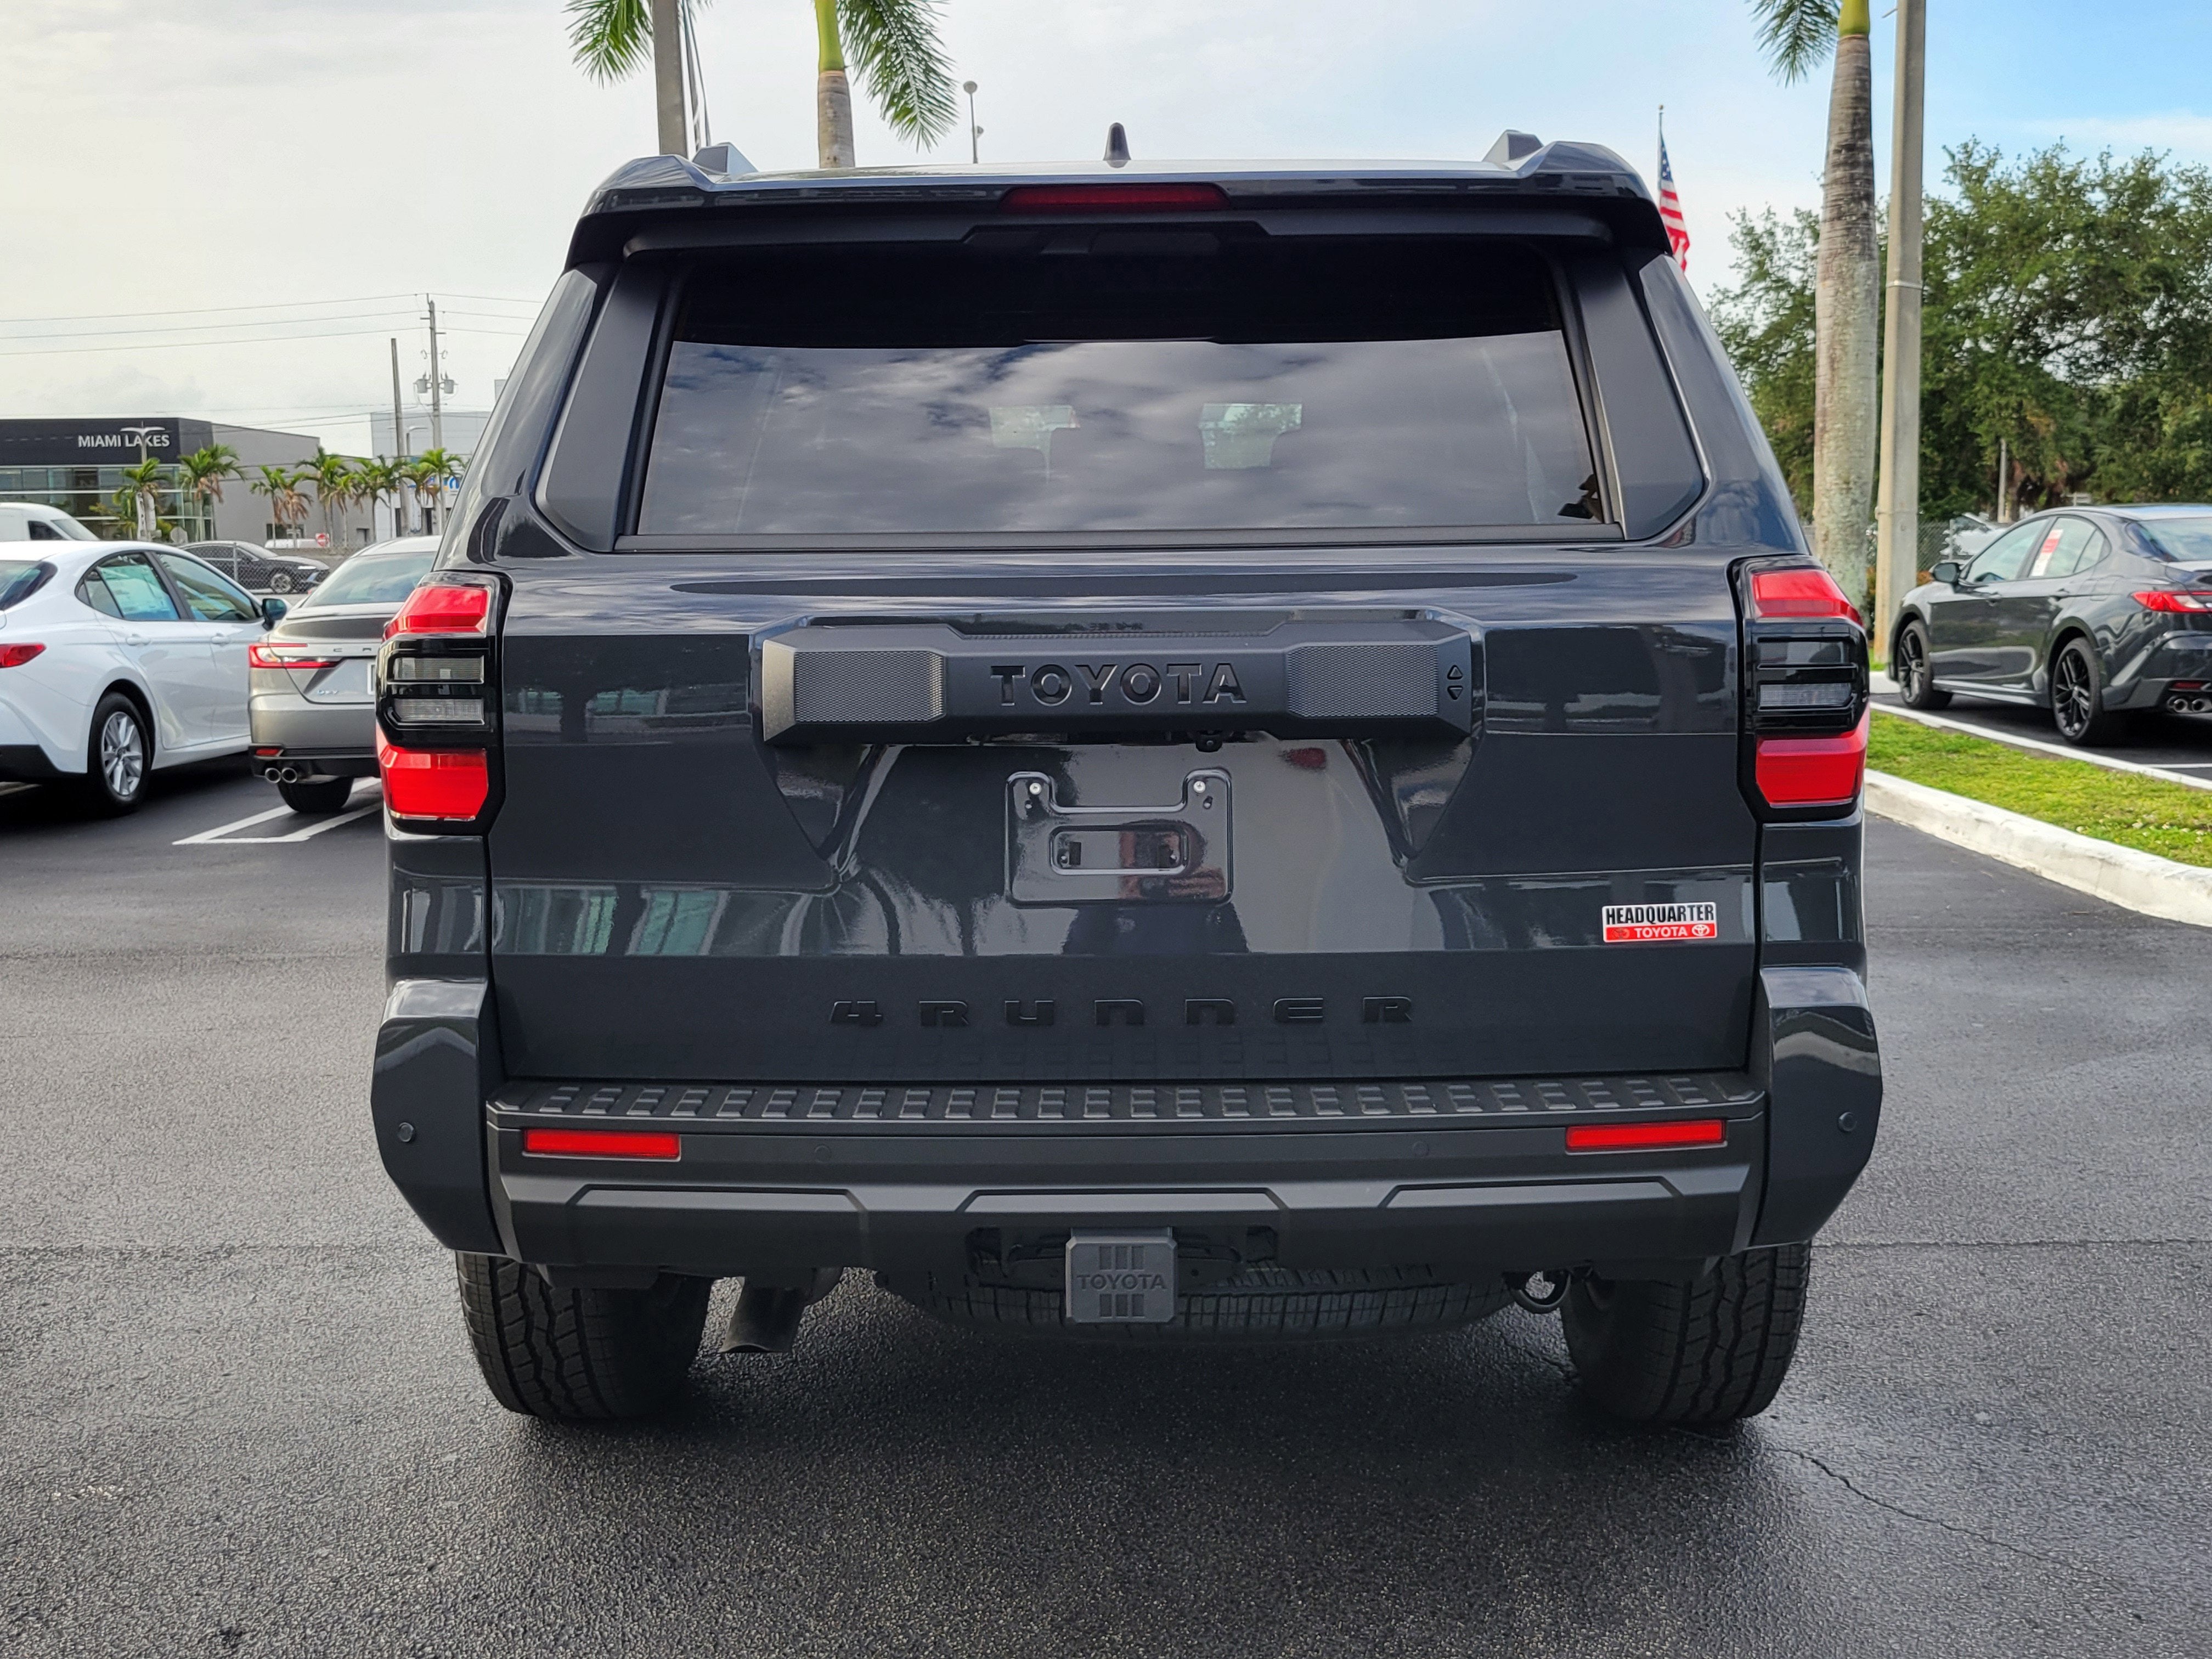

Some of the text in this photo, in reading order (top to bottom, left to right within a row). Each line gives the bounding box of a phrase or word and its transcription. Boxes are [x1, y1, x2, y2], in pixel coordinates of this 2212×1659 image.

[78, 435, 170, 448] MIAMI LAKES
[990, 663, 1247, 706] TOYOTA
[1606, 905, 1714, 925] HEADQUARTER
[1634, 926, 1688, 939] TOYOTA
[1077, 1273, 1165, 1290] TOYOTA
